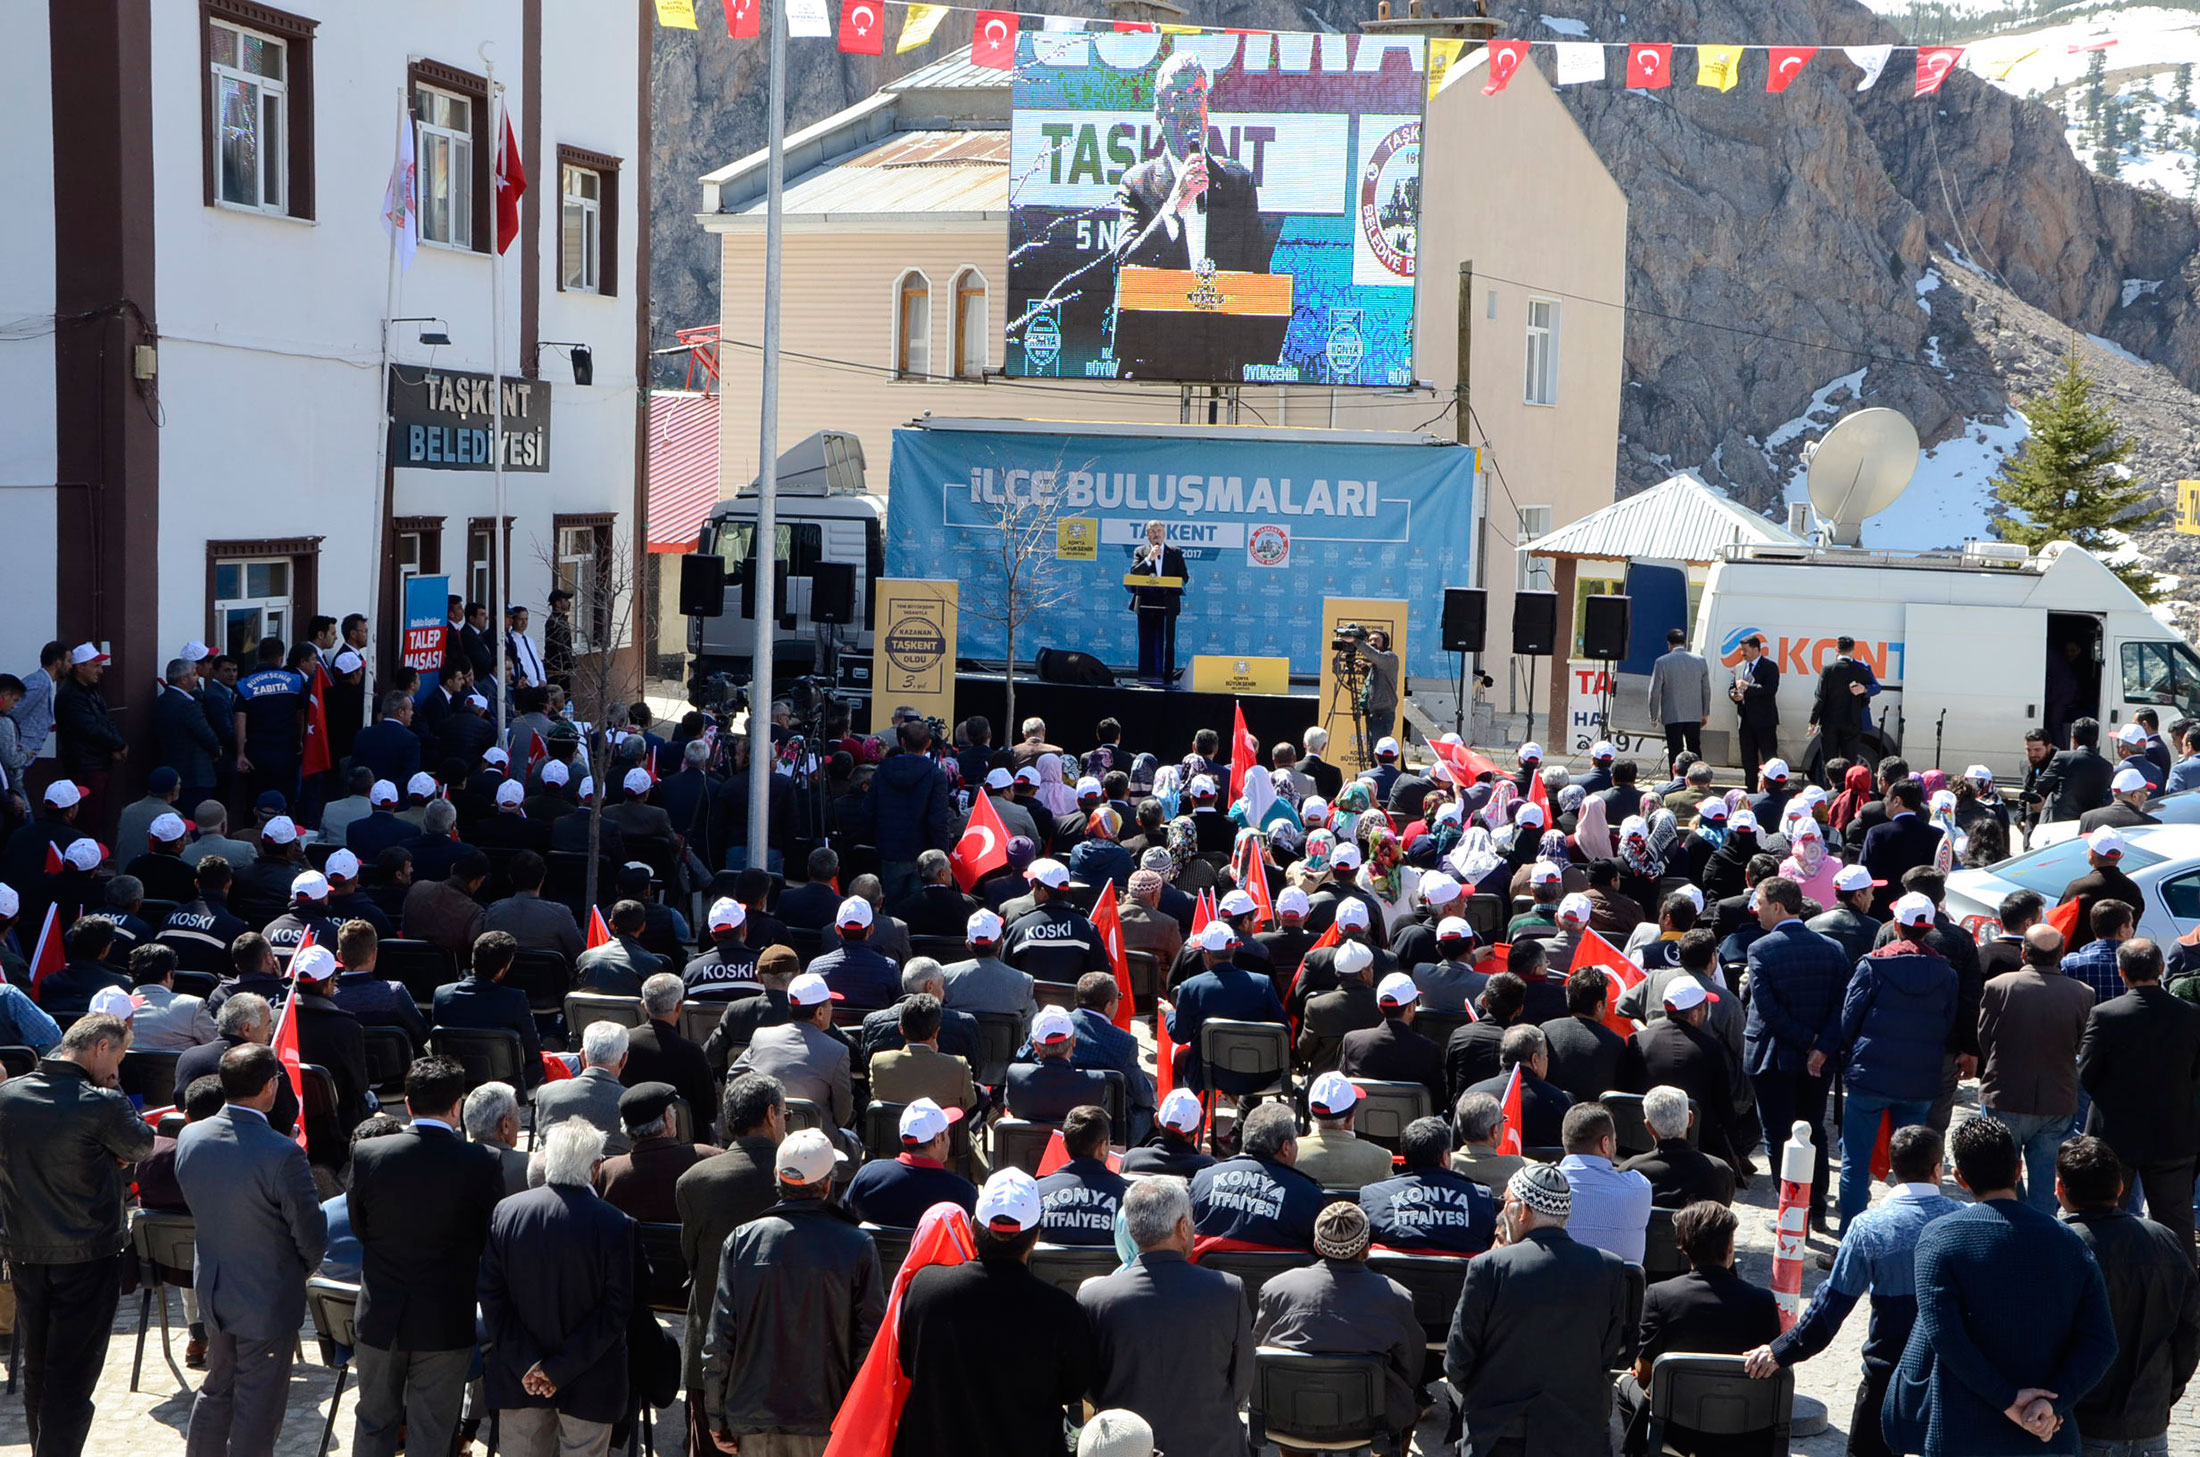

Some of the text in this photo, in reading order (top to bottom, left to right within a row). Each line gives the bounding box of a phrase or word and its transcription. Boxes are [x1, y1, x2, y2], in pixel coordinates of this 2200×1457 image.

[1076, 220, 1091, 249] 5
[425, 373, 531, 420] TAŞKENT
[410, 423, 542, 466] BELEDİYESİ
[1066, 471, 1378, 517] BULUŞMALARI
[1129, 522, 1218, 541] TAKENT
[410, 629, 441, 650] TALEP
[900, 628, 932, 636] KAZANAN
[892, 640, 938, 652] TAŞKENT
[404, 650, 443, 670] MASASI
[904, 655, 927, 664] OLDU
[252, 683, 288, 695] ZABITA
[167, 911, 216, 931] KOSKİ
[1024, 919, 1072, 940] KOSKİ
[702, 960, 754, 980] KOSKİ
[1213, 1170, 1286, 1202] KONYA
[1042, 1187, 1117, 1212] KONYA
[1208, 1187, 1282, 1221] İTFAİYESİ
[1390, 1186, 1469, 1209] KONYA
[1043, 1209, 1116, 1231] İTFAİYESİ
[1394, 1206, 1470, 1228] İTFAİYESİ
